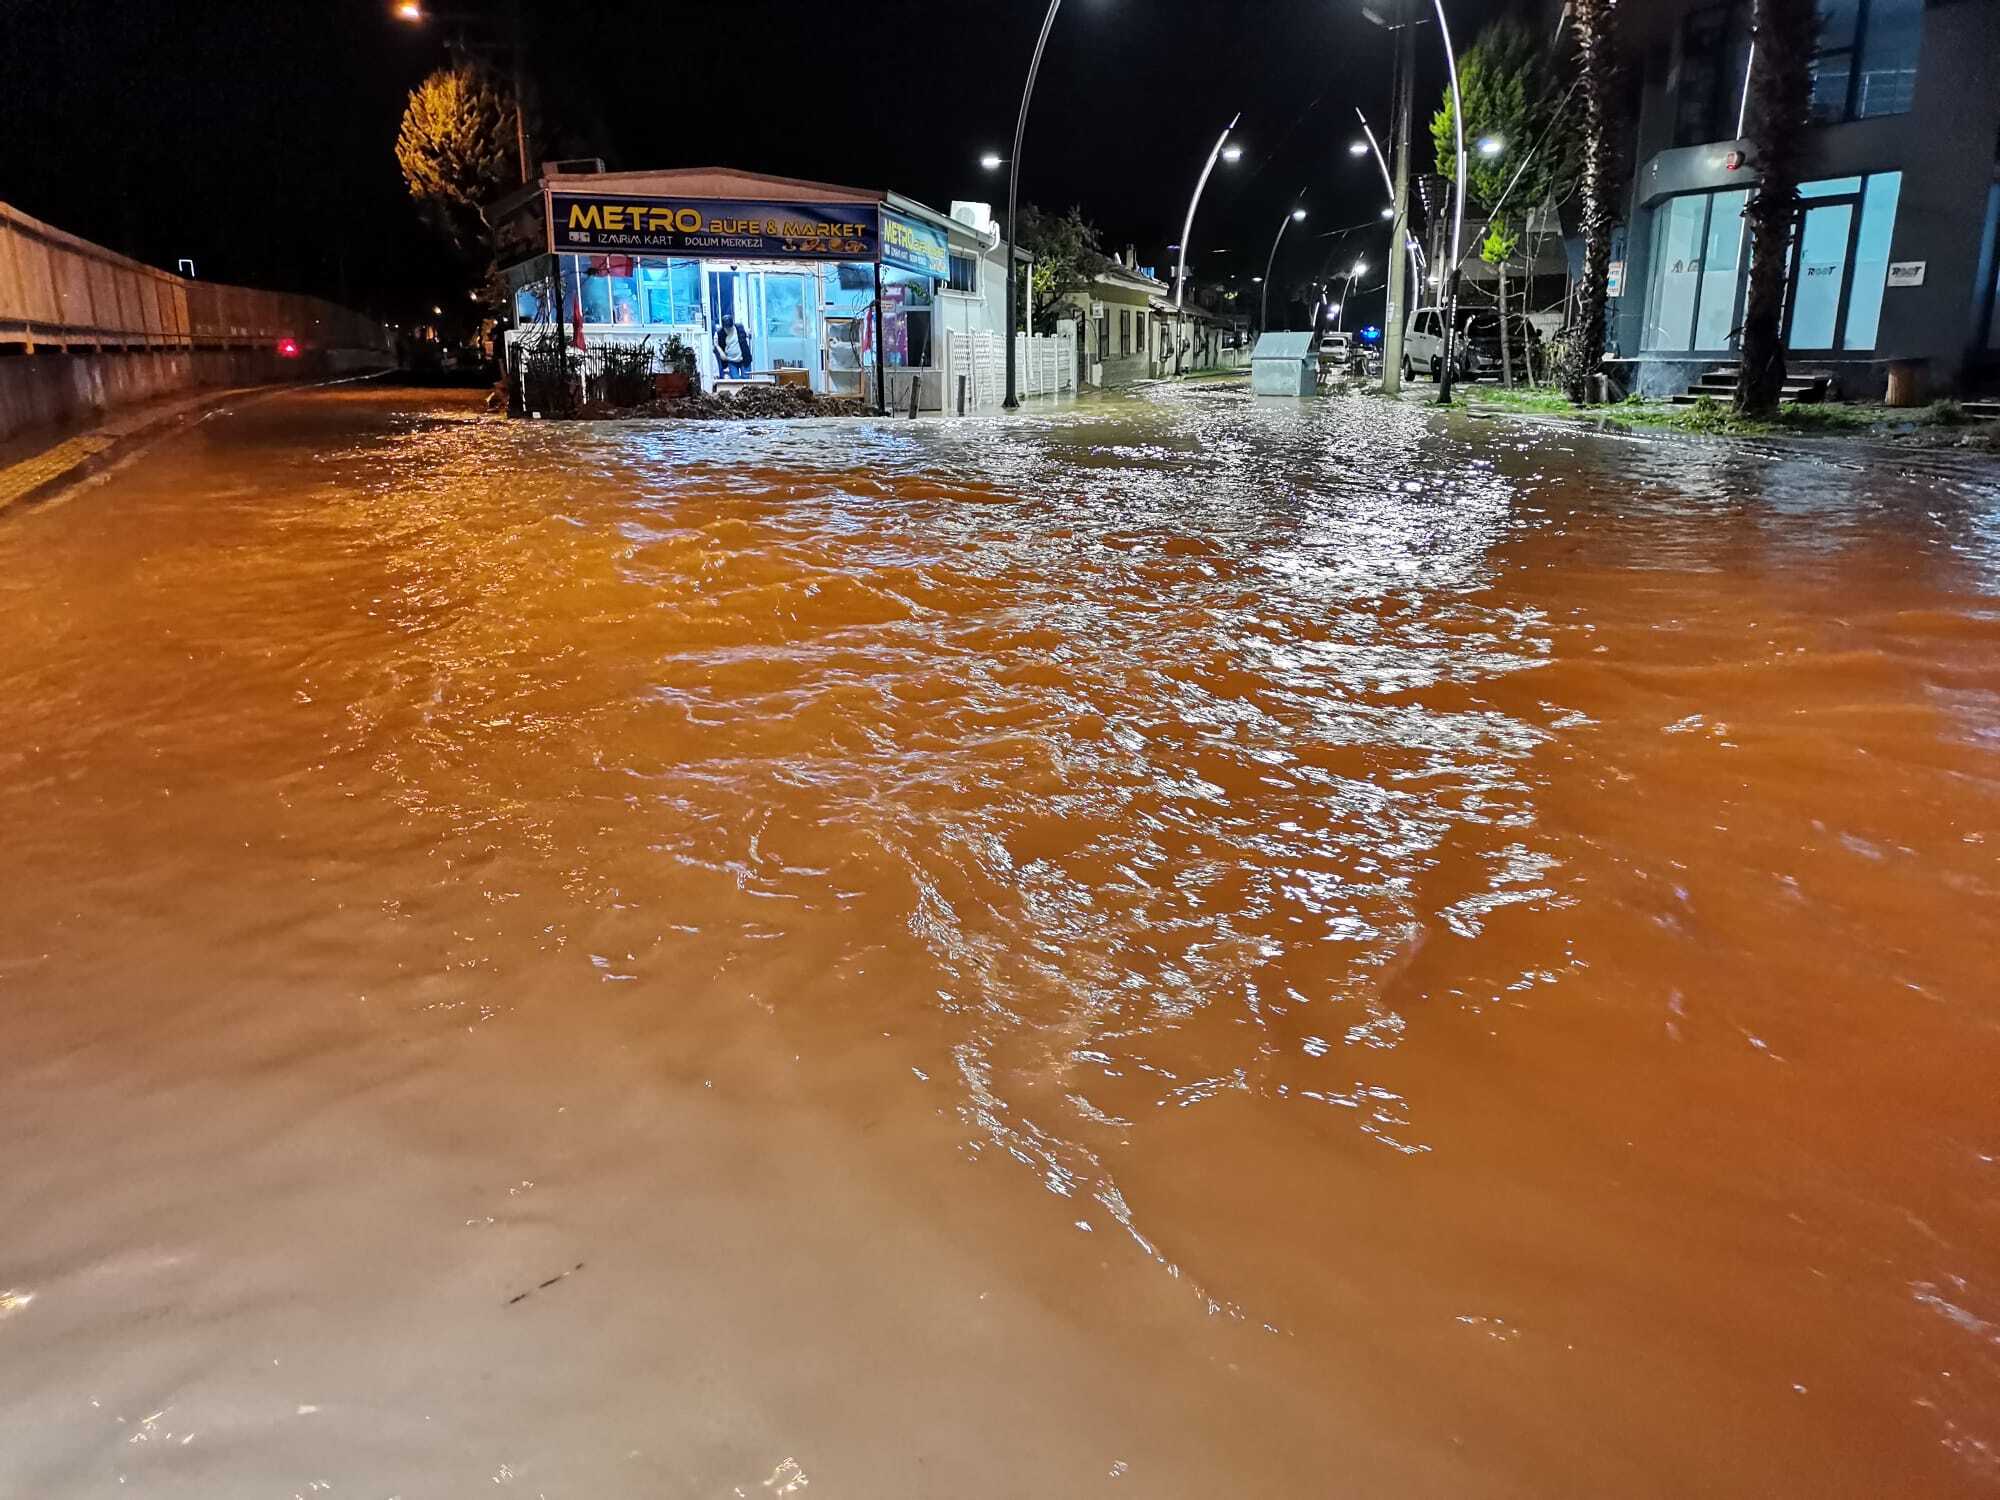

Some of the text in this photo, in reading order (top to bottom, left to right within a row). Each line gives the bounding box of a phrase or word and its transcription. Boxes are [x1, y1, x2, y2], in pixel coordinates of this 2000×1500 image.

[568, 204, 865, 237] METRO BÜFE & MARKET
[884, 217, 912, 251] METRO
[645, 235, 673, 246] KART
[685, 236, 719, 247] DOLUM
[721, 237, 763, 249] MERKEZİ
